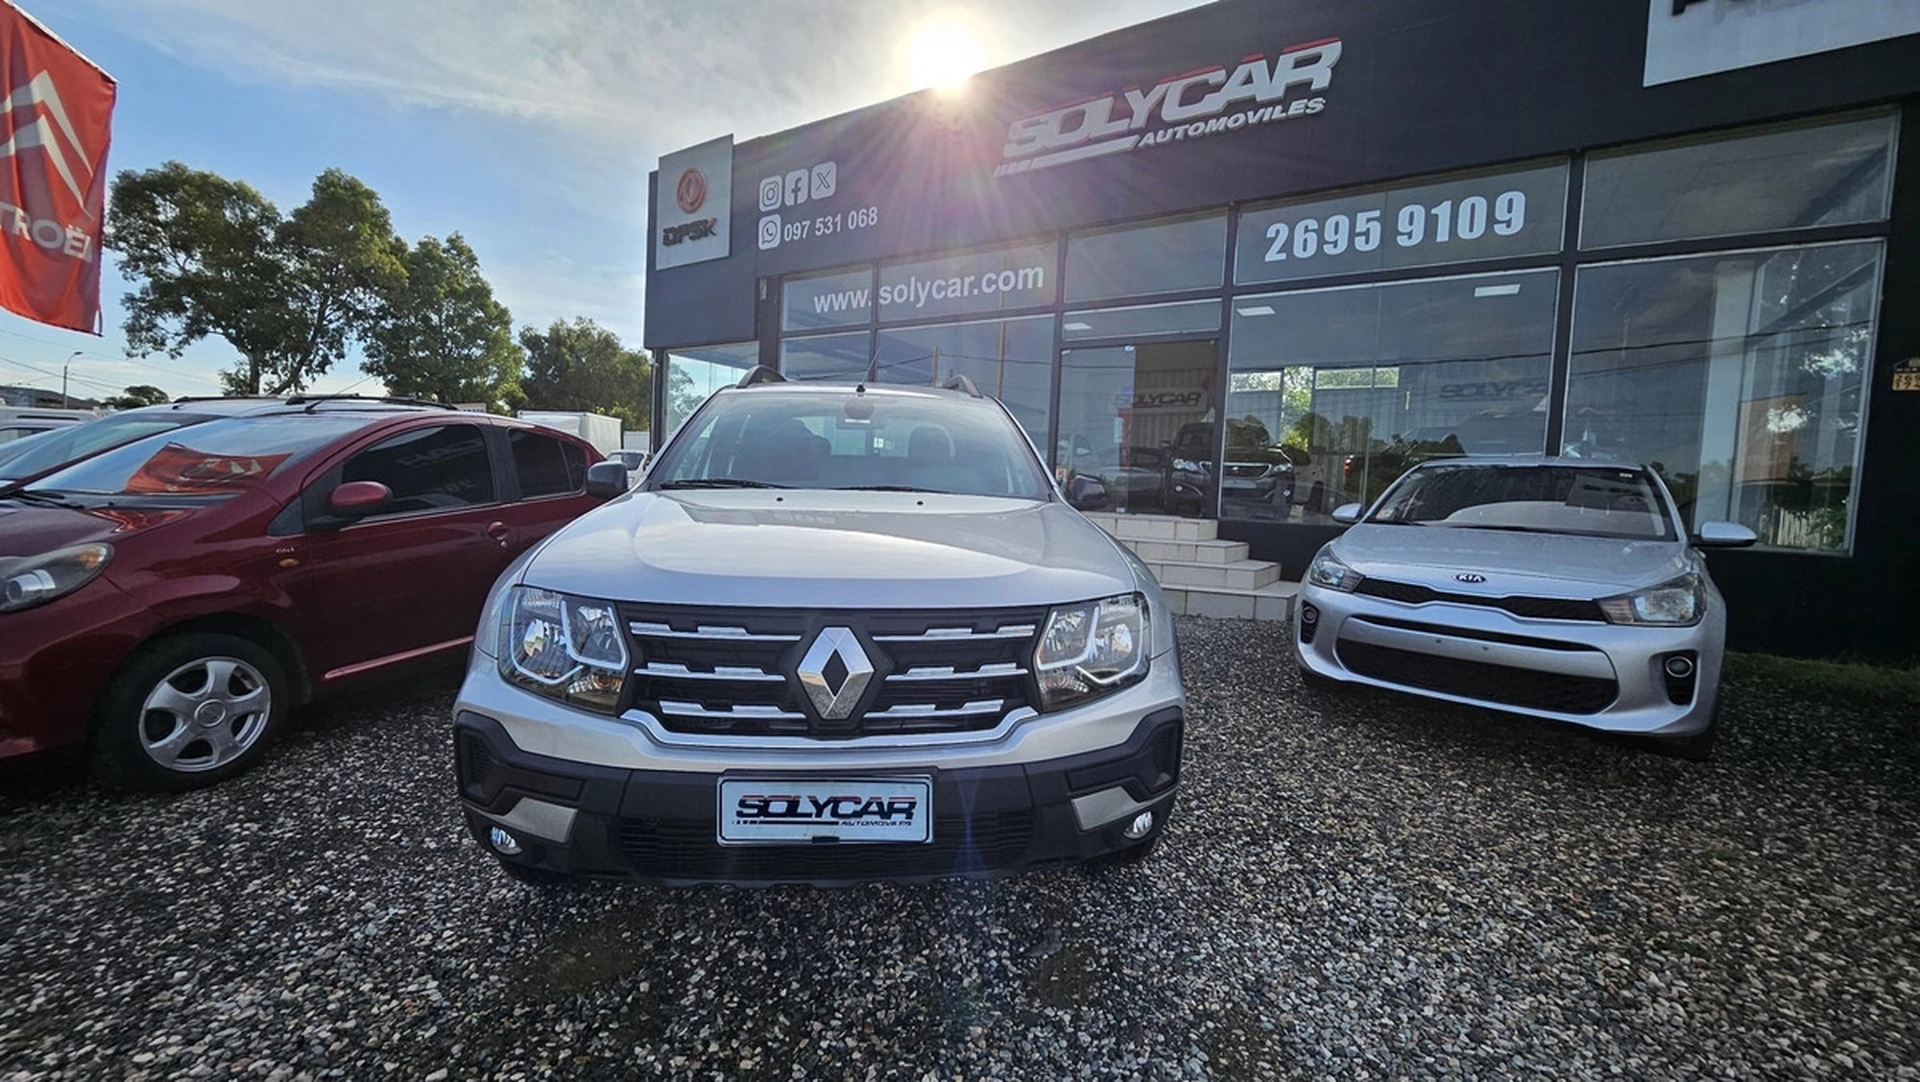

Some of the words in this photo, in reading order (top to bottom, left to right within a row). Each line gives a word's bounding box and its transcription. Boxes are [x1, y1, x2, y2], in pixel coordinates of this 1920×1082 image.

[1002, 37, 1343, 159] SOLYCAR
[1138, 97, 1327, 148] AUTOMOVILES
[783, 220, 811, 242] 097
[815, 213, 842, 236] 531
[847, 206, 878, 230] 068
[1264, 209, 1382, 262] 2695
[1396, 190, 1526, 248] 9109
[736, 795, 917, 820] SOLYCAR
